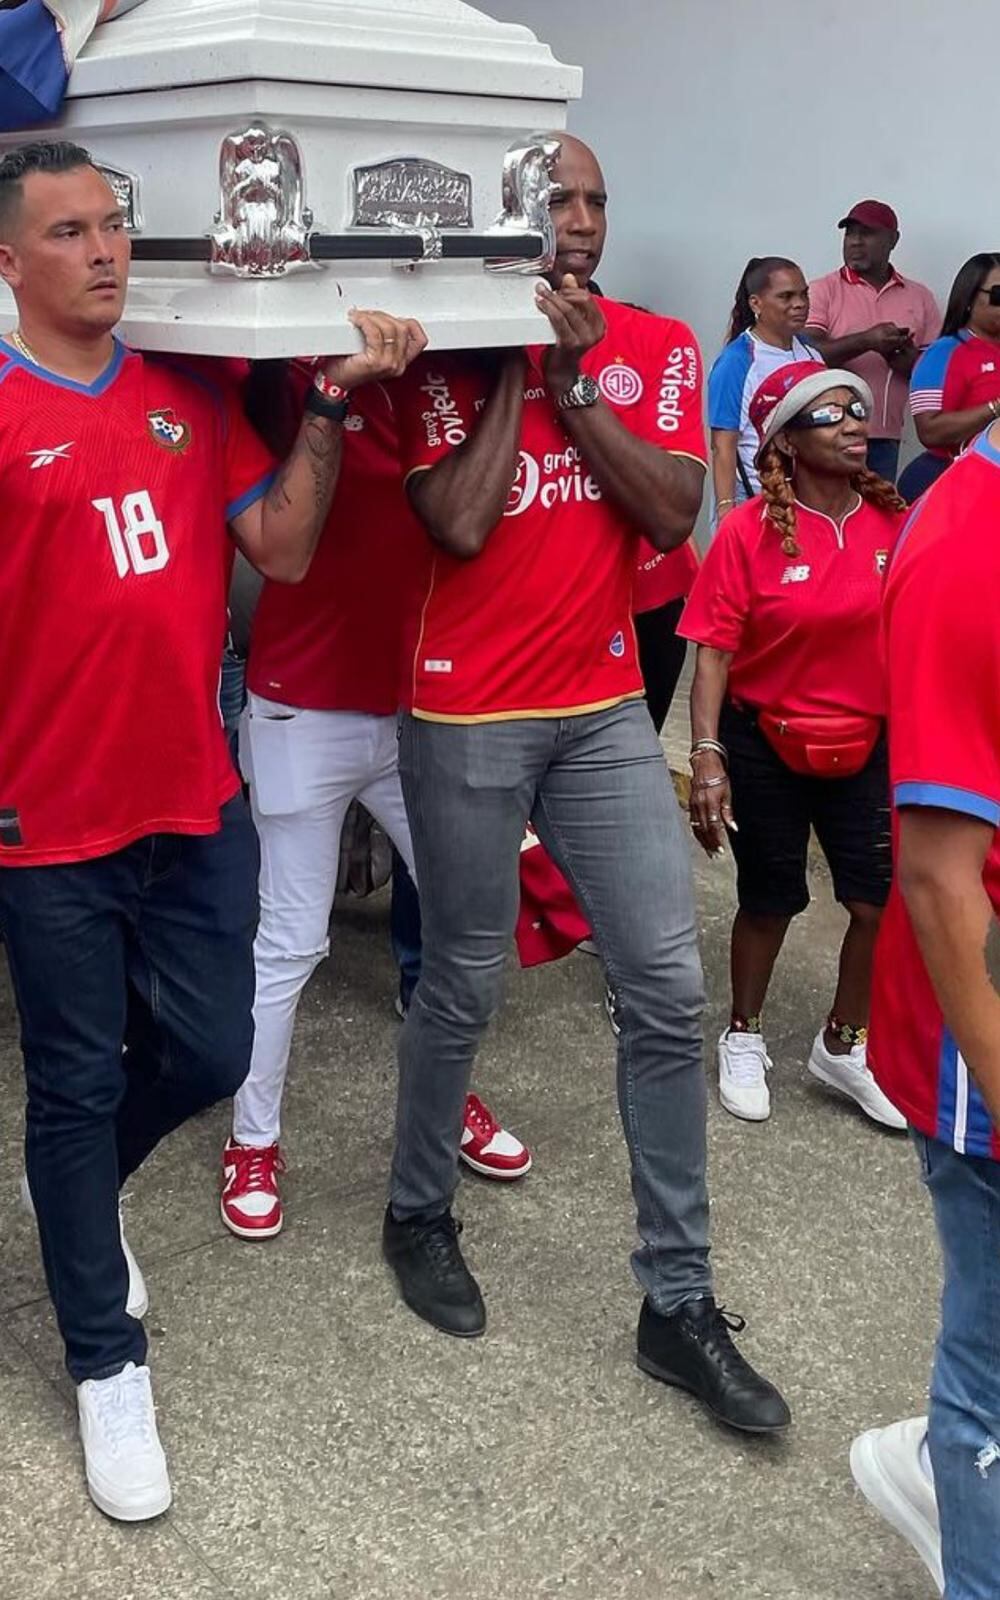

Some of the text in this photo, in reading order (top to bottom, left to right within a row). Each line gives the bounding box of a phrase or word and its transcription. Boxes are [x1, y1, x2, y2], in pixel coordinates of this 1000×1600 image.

[656, 347, 684, 432] oviedo
[540, 464, 602, 509] ovie
[91, 488, 170, 579] 18
